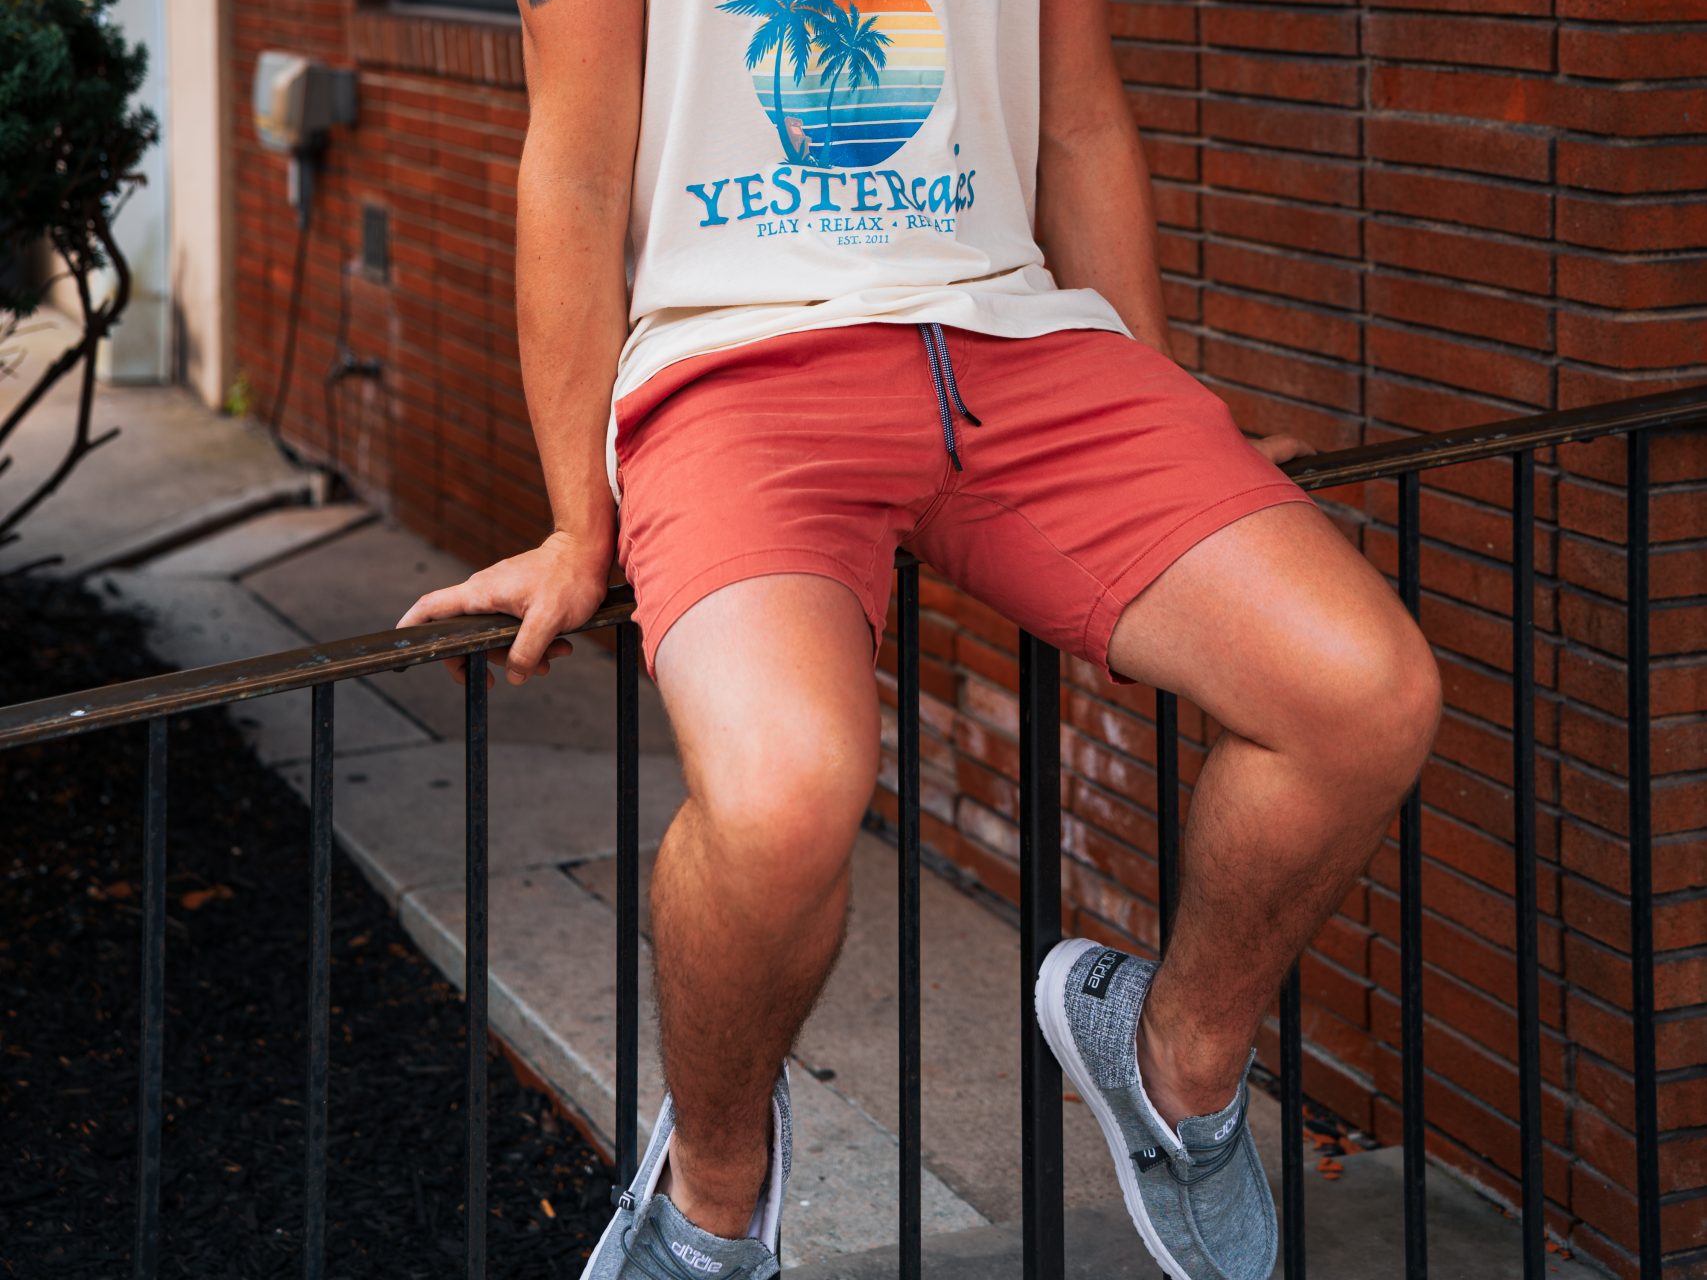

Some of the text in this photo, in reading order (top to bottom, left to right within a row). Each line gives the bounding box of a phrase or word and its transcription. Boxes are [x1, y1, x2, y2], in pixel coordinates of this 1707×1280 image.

[756, 214, 956, 238] PLAY RELAX REAT
[837, 234, 890, 246] EST. 2011
[671, 1241, 723, 1273] dude
